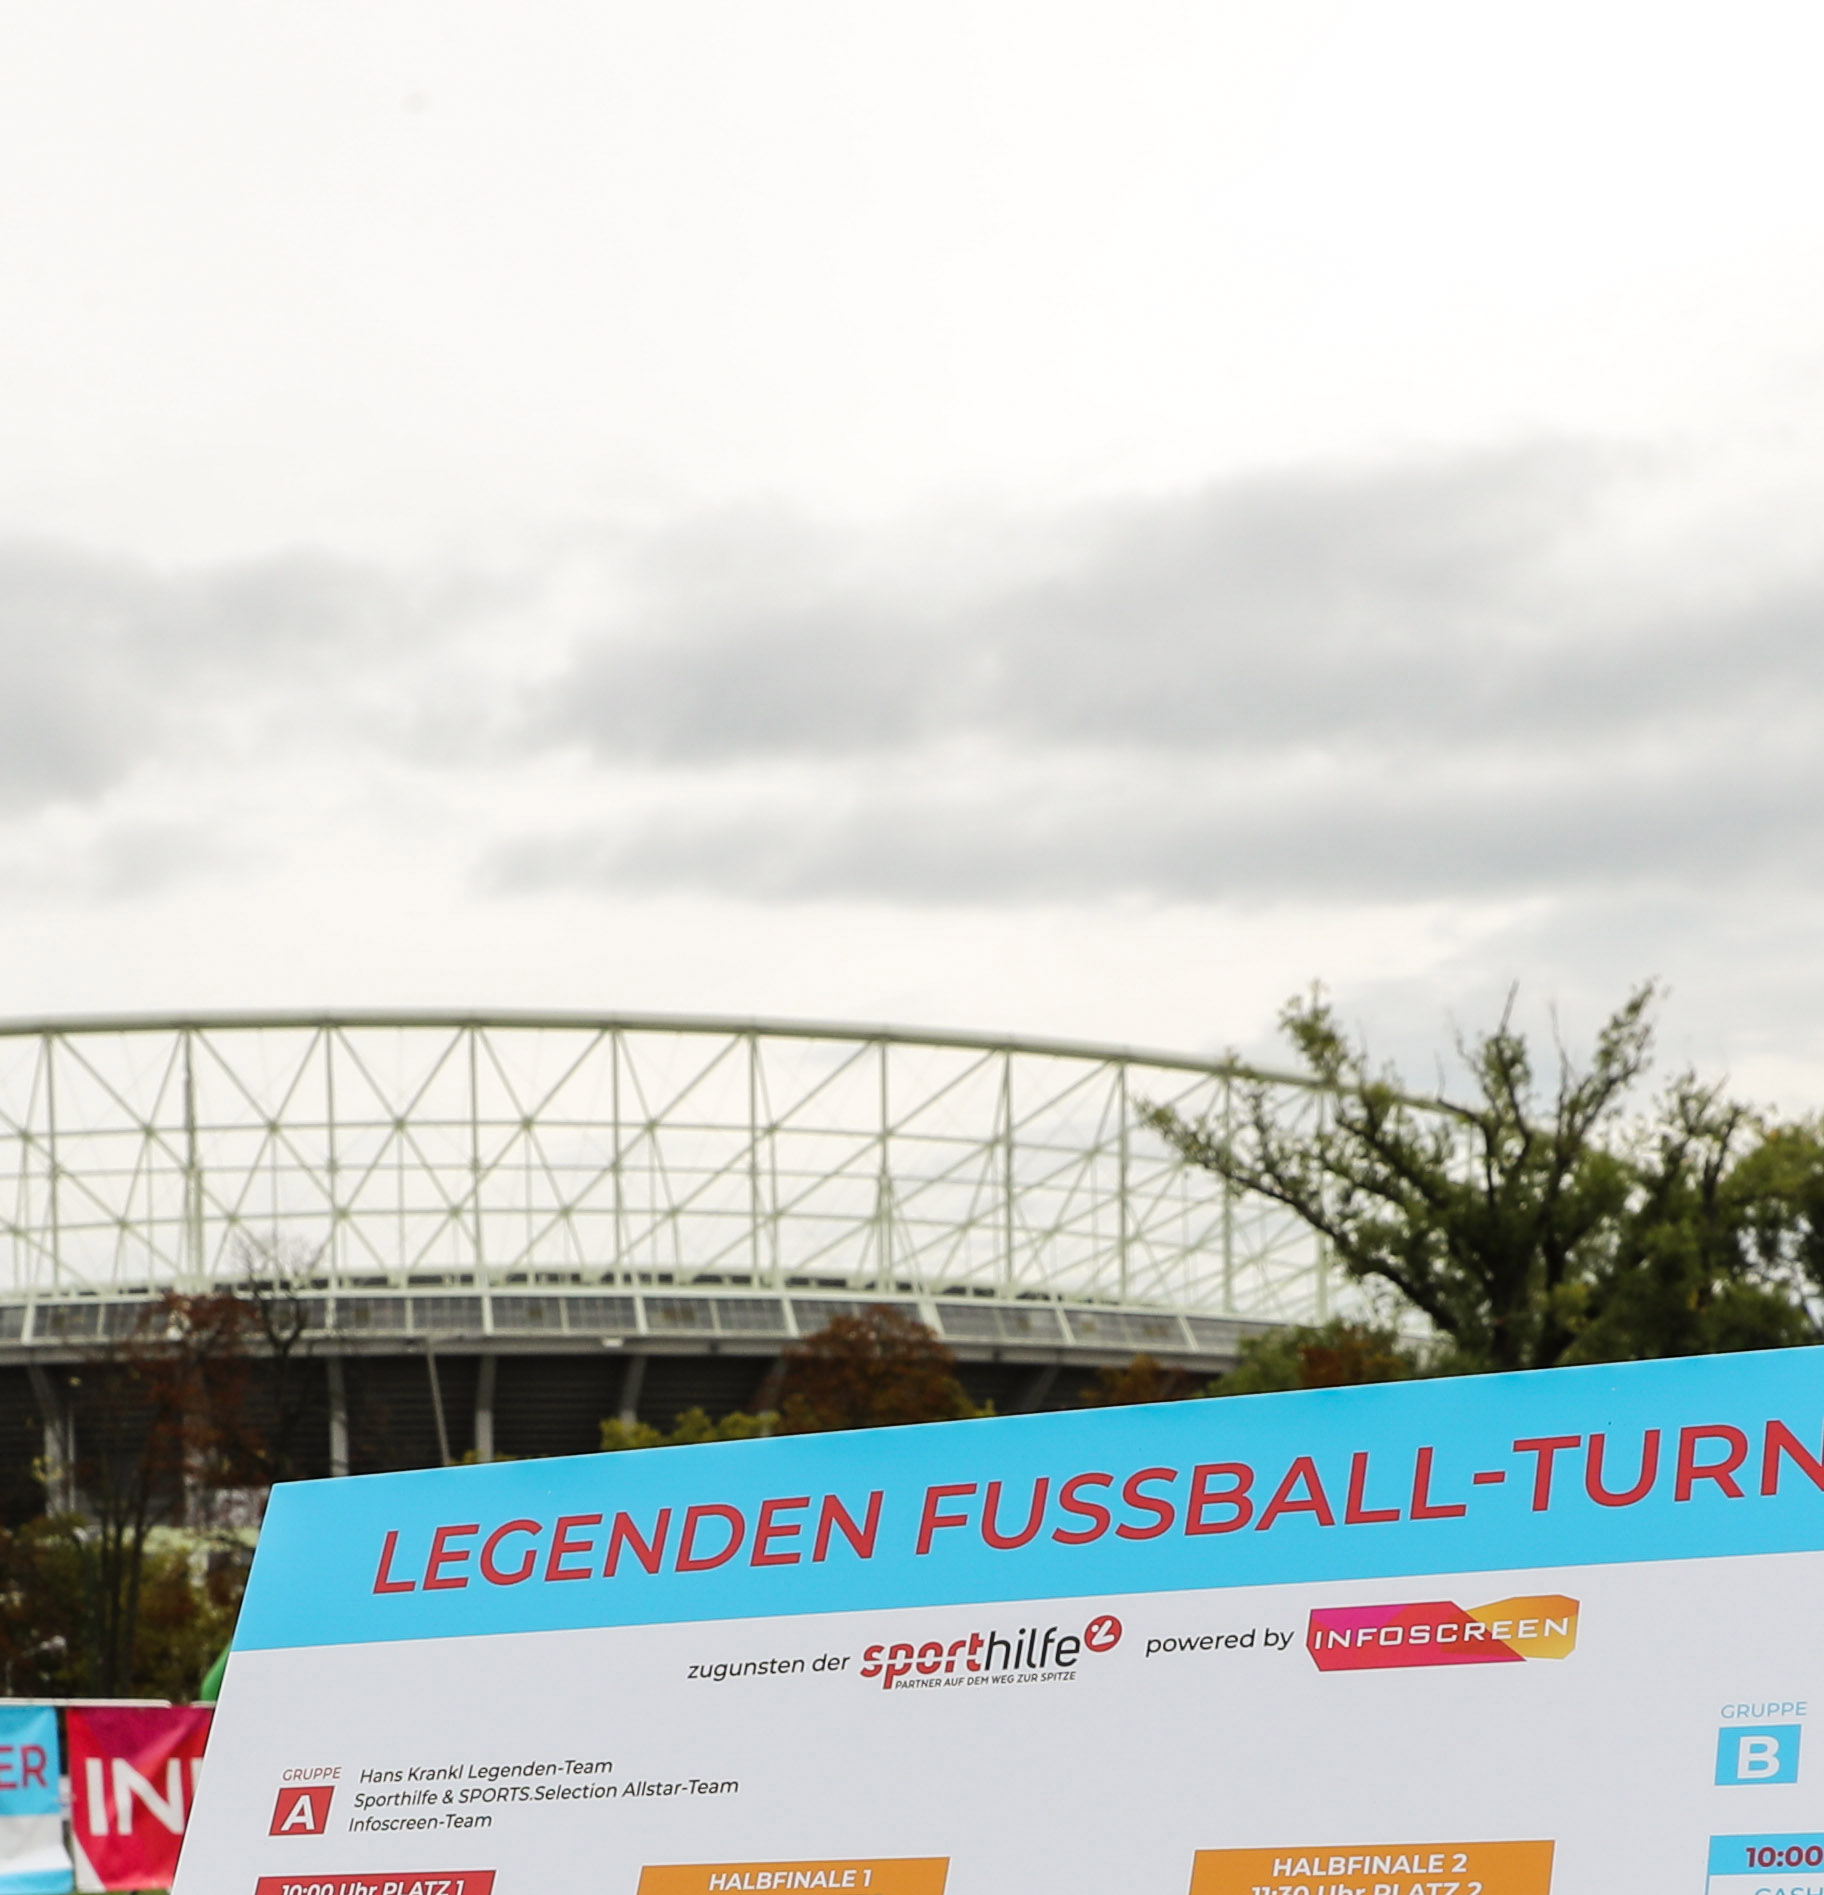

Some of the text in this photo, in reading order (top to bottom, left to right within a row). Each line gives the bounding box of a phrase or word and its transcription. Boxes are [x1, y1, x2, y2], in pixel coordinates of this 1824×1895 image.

[373, 1491, 884, 1594] LEGENDEN
[1146, 1628, 1294, 1657] powered by
[1312, 1615, 1570, 1652] INFOSCREEN
[688, 1654, 850, 1681] zugunsten der
[858, 1624, 1081, 1690] sporthilfe
[1721, 1702, 1807, 1718] GRUPPE
[1736, 1734, 1780, 1780] B
[283, 1767, 341, 1781] GRUPPE
[360, 1760, 612, 1783] Hans Krankl Legenden-Team
[354, 1780, 738, 1810] Sporthilfe & SPORTS.Selection Allstar-Team
[280, 1794, 317, 1831] A
[349, 1814, 491, 1831] Infoscreen-Team
[1273, 1854, 1468, 1876] HALBFINALE 2
[1746, 1846, 1823, 1867] 10:00
[709, 1869, 873, 1890] HALBFINALE 1
